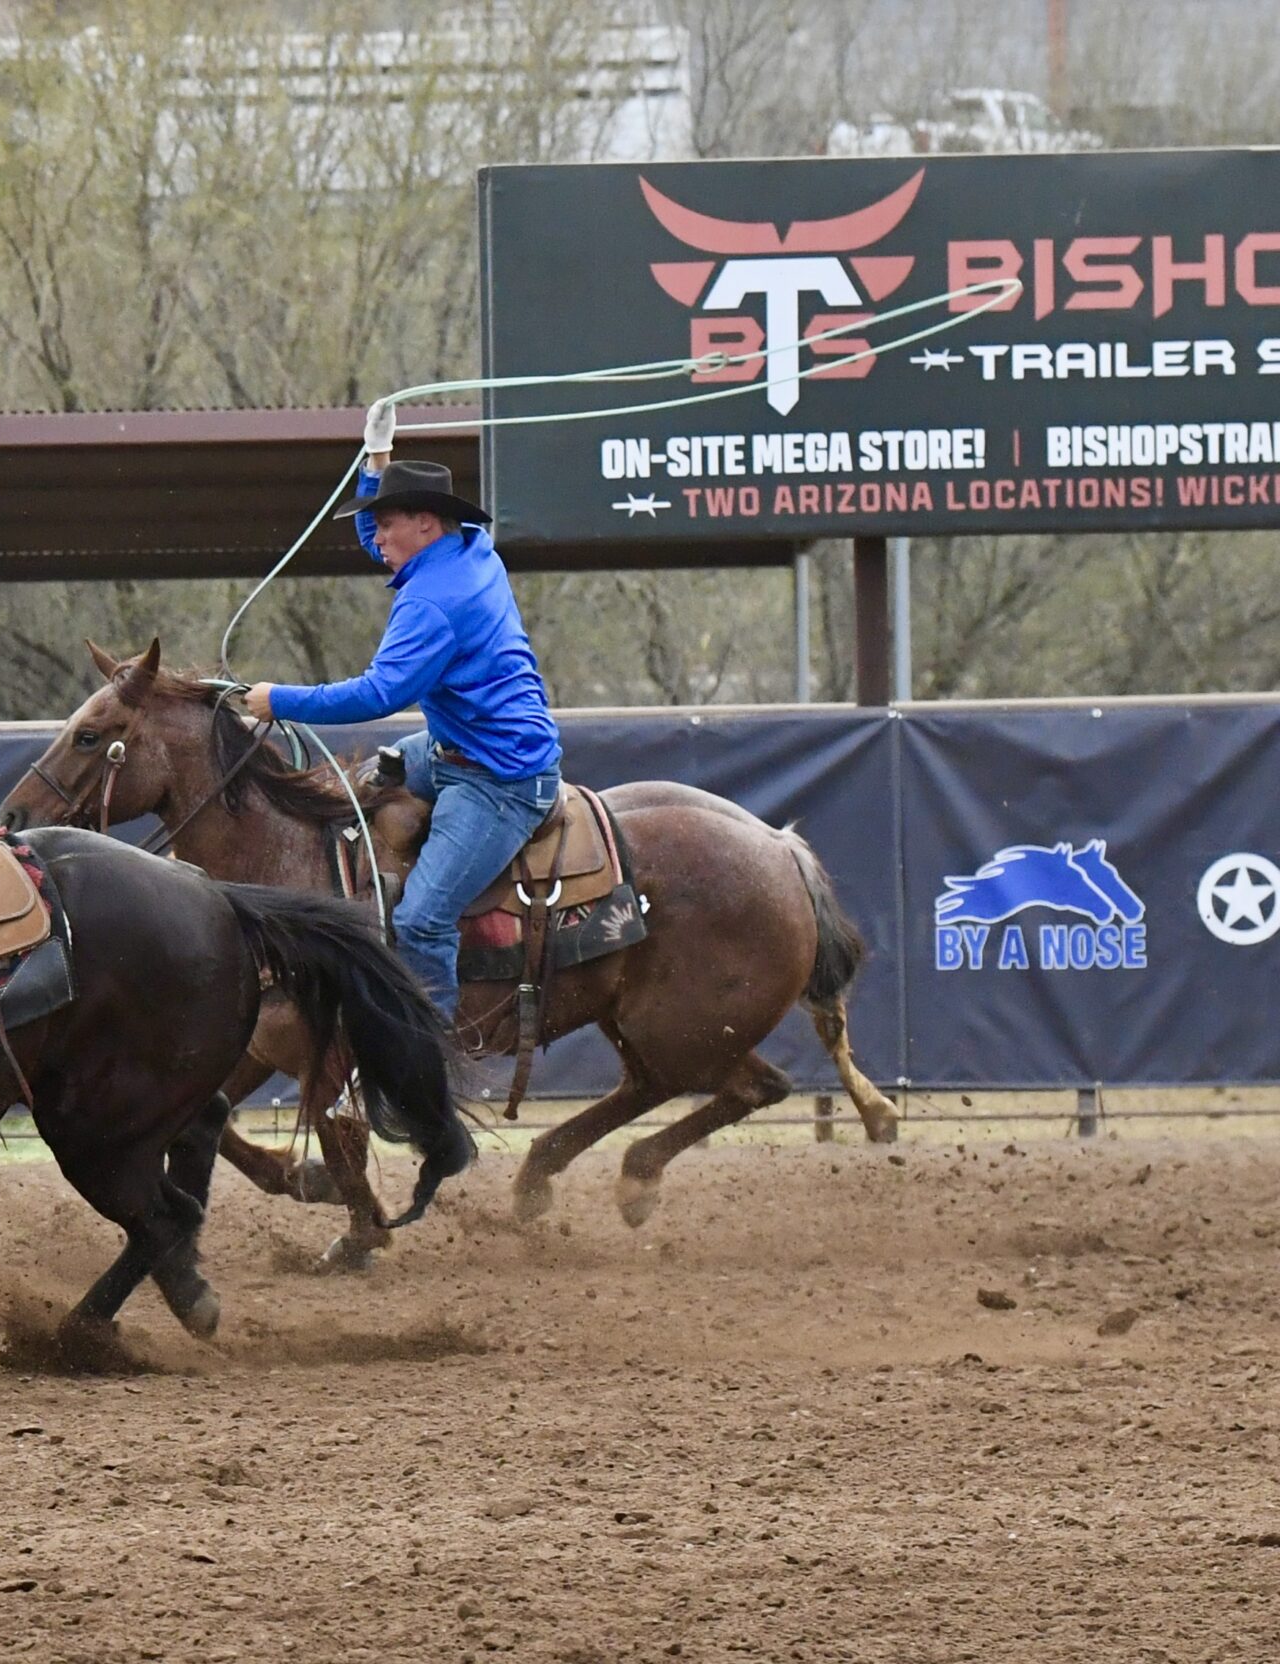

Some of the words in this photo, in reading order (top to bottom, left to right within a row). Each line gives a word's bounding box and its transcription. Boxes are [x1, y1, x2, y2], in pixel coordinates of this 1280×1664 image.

[947, 232, 1280, 321] BISHO
[968, 339, 1236, 381] TRAILER
[601, 434, 747, 480] ON-SITE
[752, 431, 854, 476] MEGA
[858, 428, 987, 471] STORE!
[682, 487, 761, 518] TWO
[772, 481, 935, 515] ARIZONA
[946, 476, 1164, 511] LOCATIONS!
[935, 925, 990, 970] BY
[997, 925, 1030, 970] A
[1040, 923, 1148, 970] NOSE
